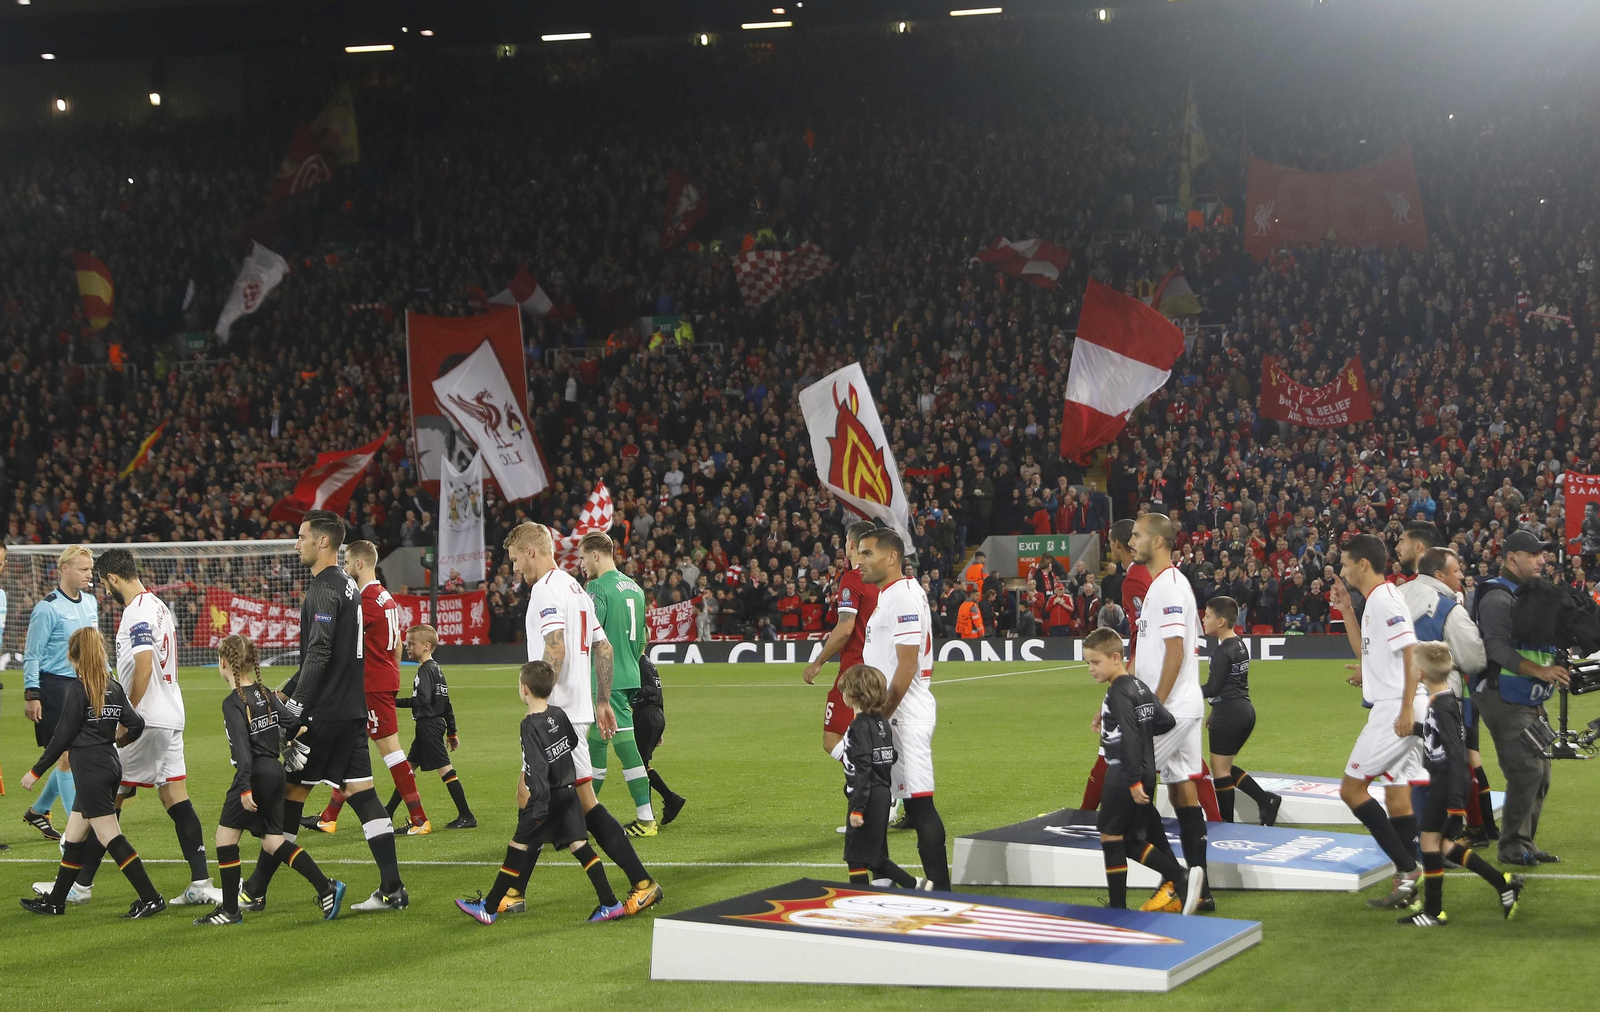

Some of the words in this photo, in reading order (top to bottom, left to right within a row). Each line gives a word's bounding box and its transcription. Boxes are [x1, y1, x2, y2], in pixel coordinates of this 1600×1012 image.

[1317, 398, 1352, 416] BELIEF
[1305, 412, 1349, 426] SUCCESS
[1018, 541, 1041, 551] EXIT
[230, 597, 264, 614] PRIDE
[268, 605, 281, 617] IN
[420, 611, 463, 624] BYOND
[625, 598, 637, 641] 1
[652, 614, 671, 626] THE
[826, 702, 835, 719] 6
